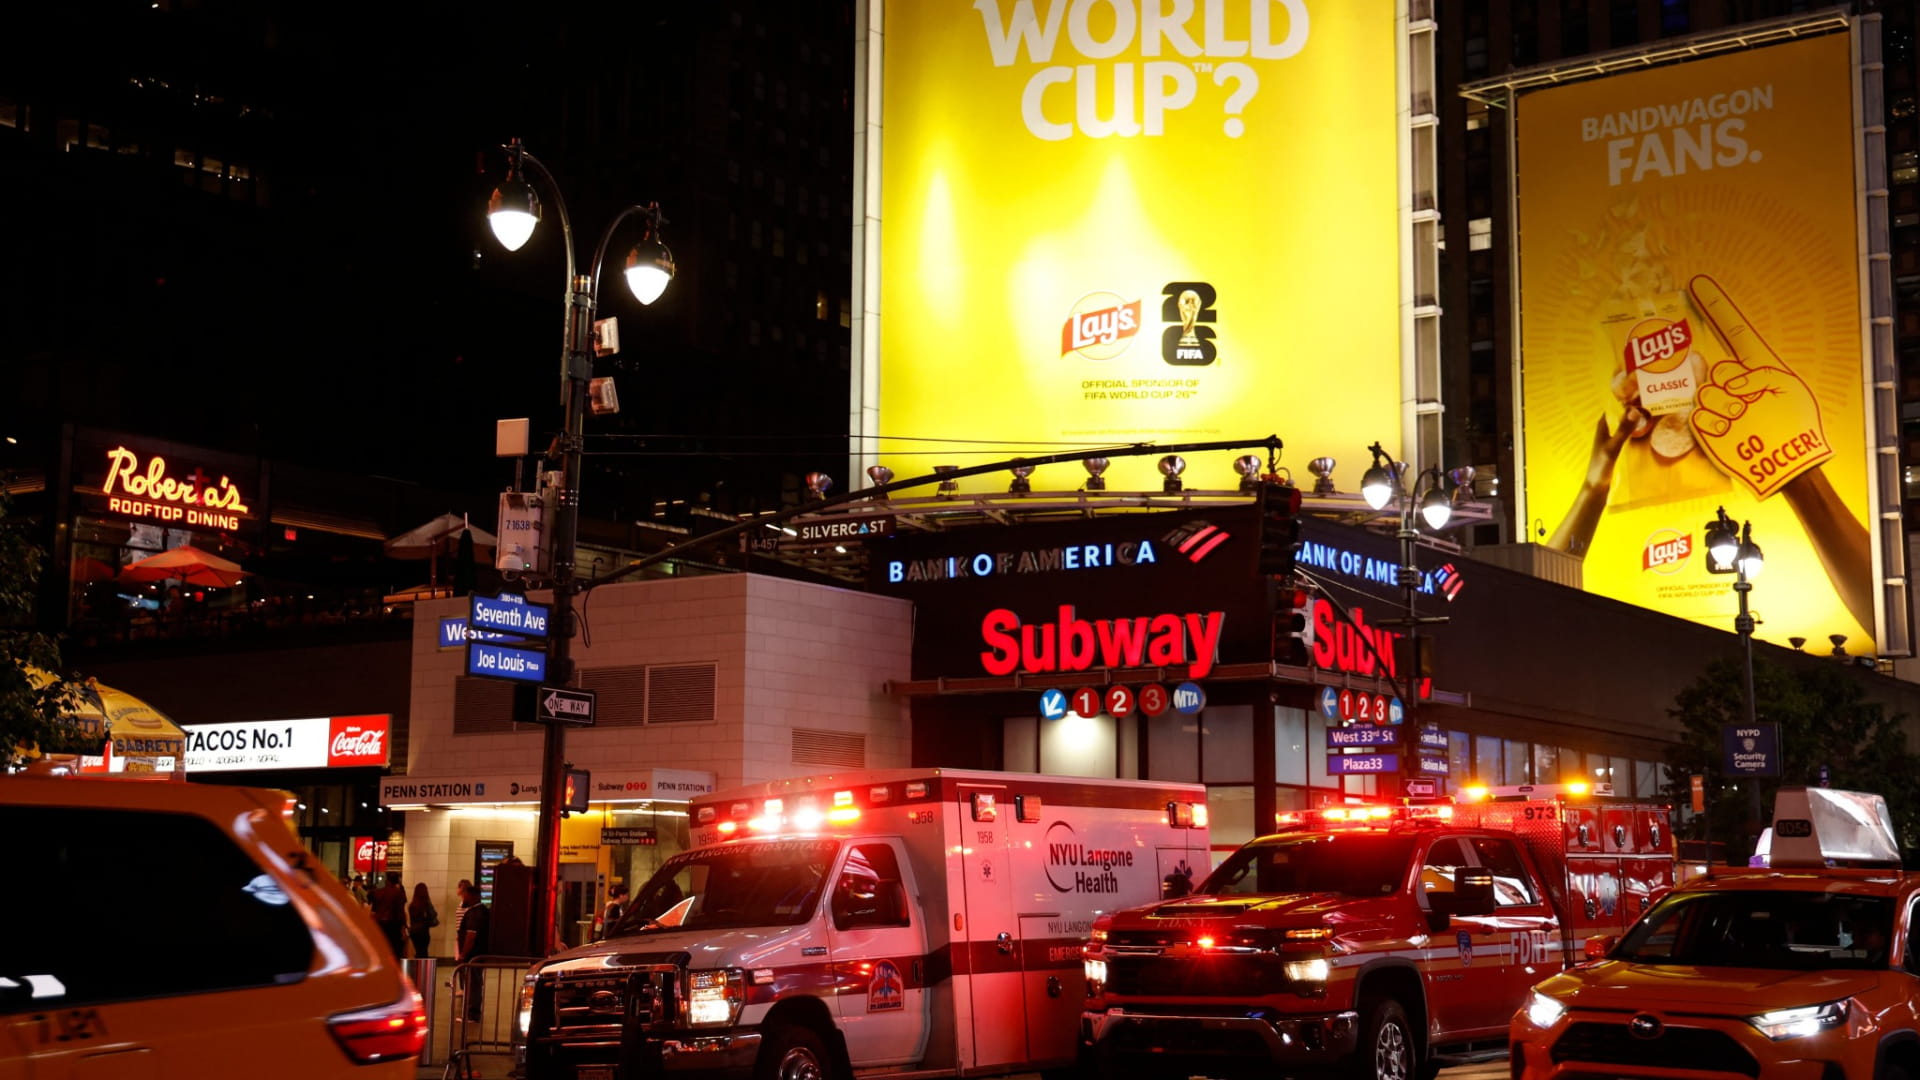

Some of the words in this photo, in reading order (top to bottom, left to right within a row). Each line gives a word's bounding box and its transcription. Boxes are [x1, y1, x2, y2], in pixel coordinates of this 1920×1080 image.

[973, 0, 1310, 67] WORLD
[1581, 84, 1774, 142] BANDWAGON
[1608, 118, 1763, 186] FANS.
[1072, 304, 1137, 349] Lay's
[1176, 348, 1204, 360] FIFA
[1631, 325, 1686, 368] Lay's
[1081, 380, 1128, 390] OFFICIAL
[1131, 379, 1183, 389] SPONSOR
[1185, 378, 1201, 388] OF
[1646, 378, 1690, 394] CLASSIC
[1084, 391, 1107, 400] FIFA
[1110, 390, 1148, 399] WORLD
[1150, 390, 1174, 399] CUP
[1735, 434, 1765, 461] GO
[1748, 429, 1823, 484] SOCCER!
[109, 498, 183, 520] ROOFTOP
[187, 510, 239, 531] DINING
[802, 520, 887, 540] SILVERCAST
[888, 556, 969, 582] BANK
[972, 551, 1015, 576] OF
[1017, 541, 1156, 573] AMERICA
[1648, 538, 1690, 567] Lay's
[1295, 540, 1336, 571] ANK
[1340, 550, 1361, 576] OF
[1364, 558, 1435, 595] AMEA
[475, 602, 521, 628] Seventh
[523, 611, 545, 631] Ave
[981, 604, 1225, 679] Subway
[477, 650, 496, 669] Joe
[498, 652, 525, 673] Louis
[526, 661, 539, 671] Plaza
[549, 699, 564, 710] ONE
[570, 701, 585, 713] WAY
[1079, 692, 1090, 714] 1
[1112, 691, 1127, 713] 2
[1146, 688, 1161, 711] 3
[1174, 689, 1200, 708] MTA
[1343, 691, 1350, 716] 1
[1359, 693, 1369, 719] 2
[1375, 696, 1385, 722] 3
[111, 707, 150, 720] SABRETT
[185, 729, 247, 752] TACOS
[252, 727, 293, 749] No.1
[331, 729, 385, 757] Coca-Cola
[1332, 731, 1360, 743] West
[1360, 730, 1380, 743] 33rd
[1382, 729, 1394, 742] St
[1736, 729, 1761, 737] NYPD
[115, 739, 183, 753] SABRETT
[1733, 752, 1767, 761] Security
[1343, 758, 1383, 771] Plaza33
[1735, 760, 1766, 768] Camera
[384, 785, 417, 798] PENN
[420, 784, 471, 798] STATION
[521, 784, 538, 794] Long
[598, 783, 624, 793] Subway
[657, 783, 676, 791] PENN
[678, 784, 705, 792] STATION
[1524, 806, 1555, 820] 973
[976, 831, 994, 844] 1958
[1049, 843, 1078, 868] NYU
[1079, 846, 1133, 870] Langone
[1075, 871, 1119, 894] Health
[1048, 922, 1063, 934] NYU
[1064, 921, 1092, 933] LANGON
[1049, 946, 1080, 962] EMERGE
[1510, 931, 1551, 965] FDNY
